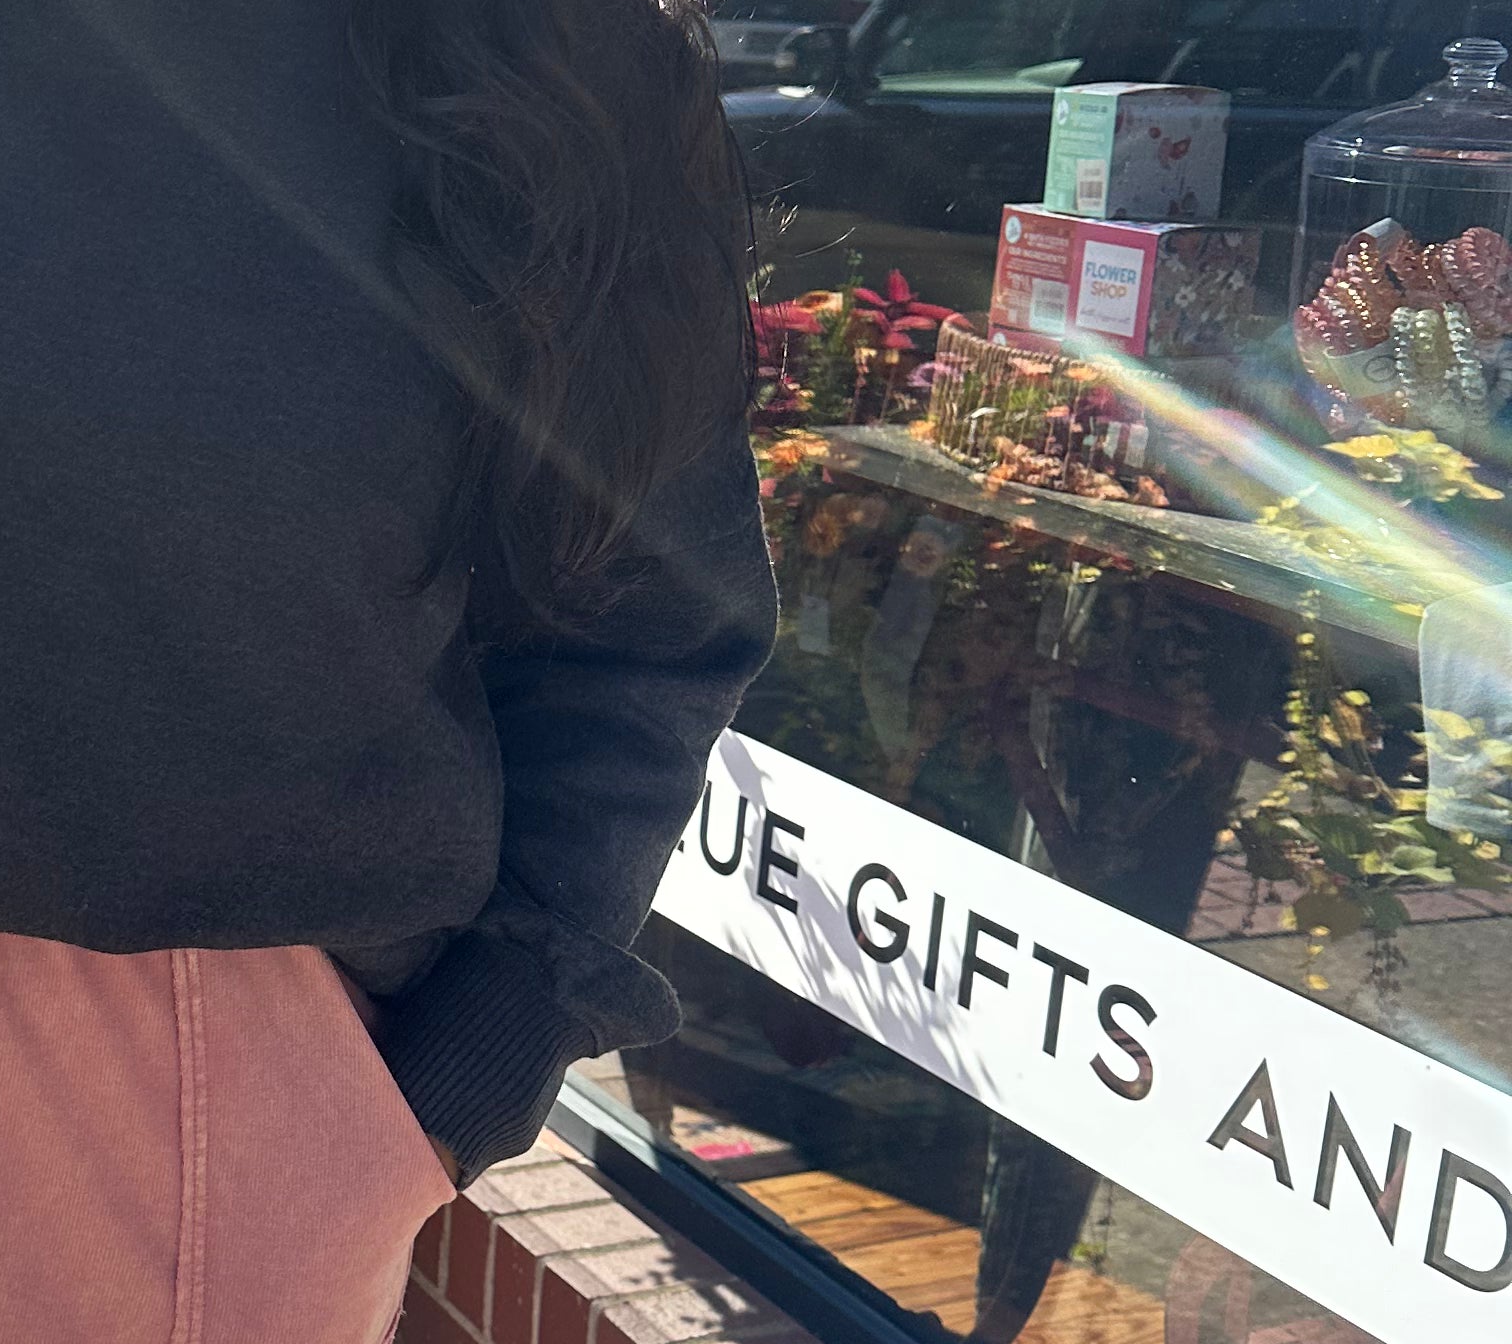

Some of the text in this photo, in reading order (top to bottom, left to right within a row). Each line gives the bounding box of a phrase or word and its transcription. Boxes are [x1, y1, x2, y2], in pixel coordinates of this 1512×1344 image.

[1085, 261, 1138, 286] FLOWER
[1090, 281, 1129, 301] SHOP
[677, 780, 1512, 1293] UE GIFTS AND
